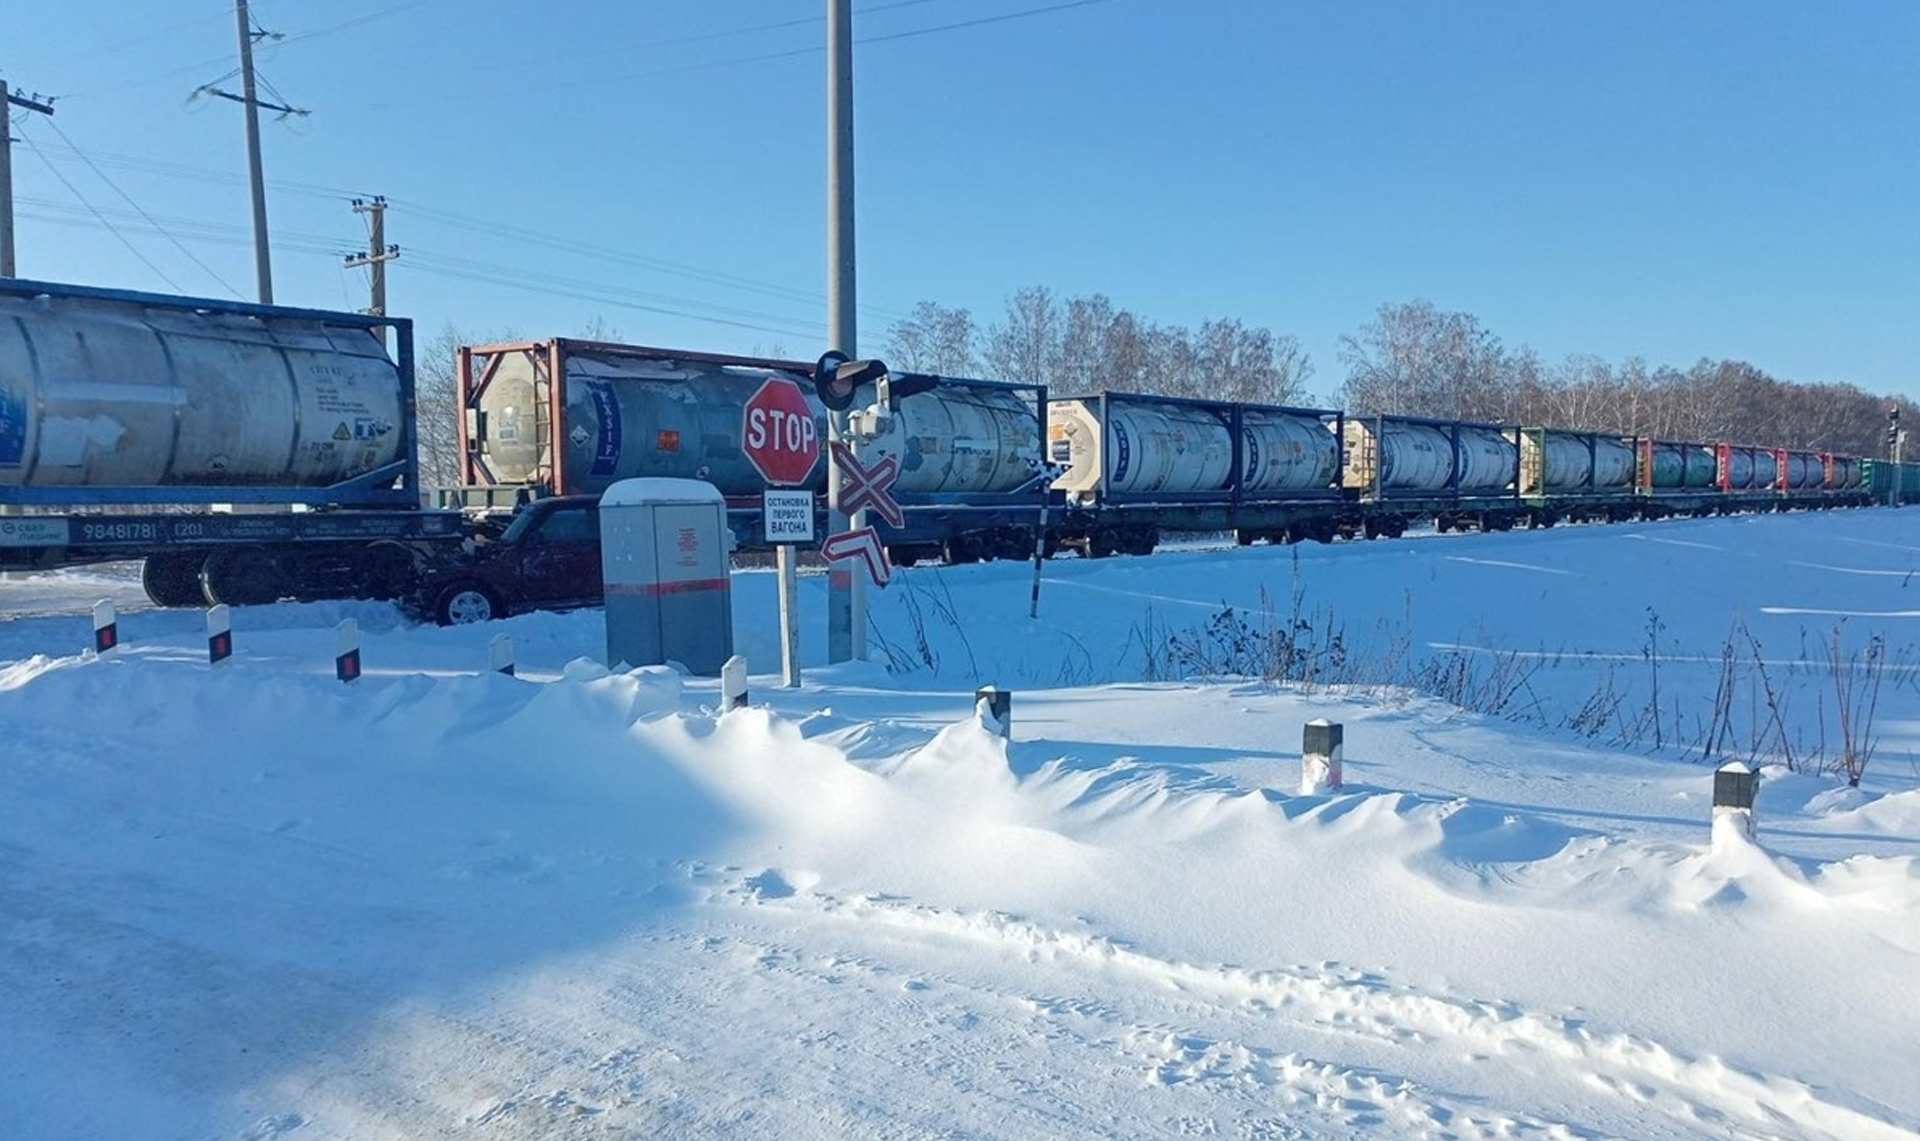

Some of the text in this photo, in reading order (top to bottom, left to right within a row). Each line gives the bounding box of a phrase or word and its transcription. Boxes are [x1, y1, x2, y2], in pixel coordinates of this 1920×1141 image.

[748, 408, 815, 453] STOP
[767, 497, 810, 507] ОСТАНОВКА
[773, 509, 805, 519] ПЕРВОГО
[83, 524, 157, 539] 98481781
[771, 521, 807, 533] ВАГОНА
